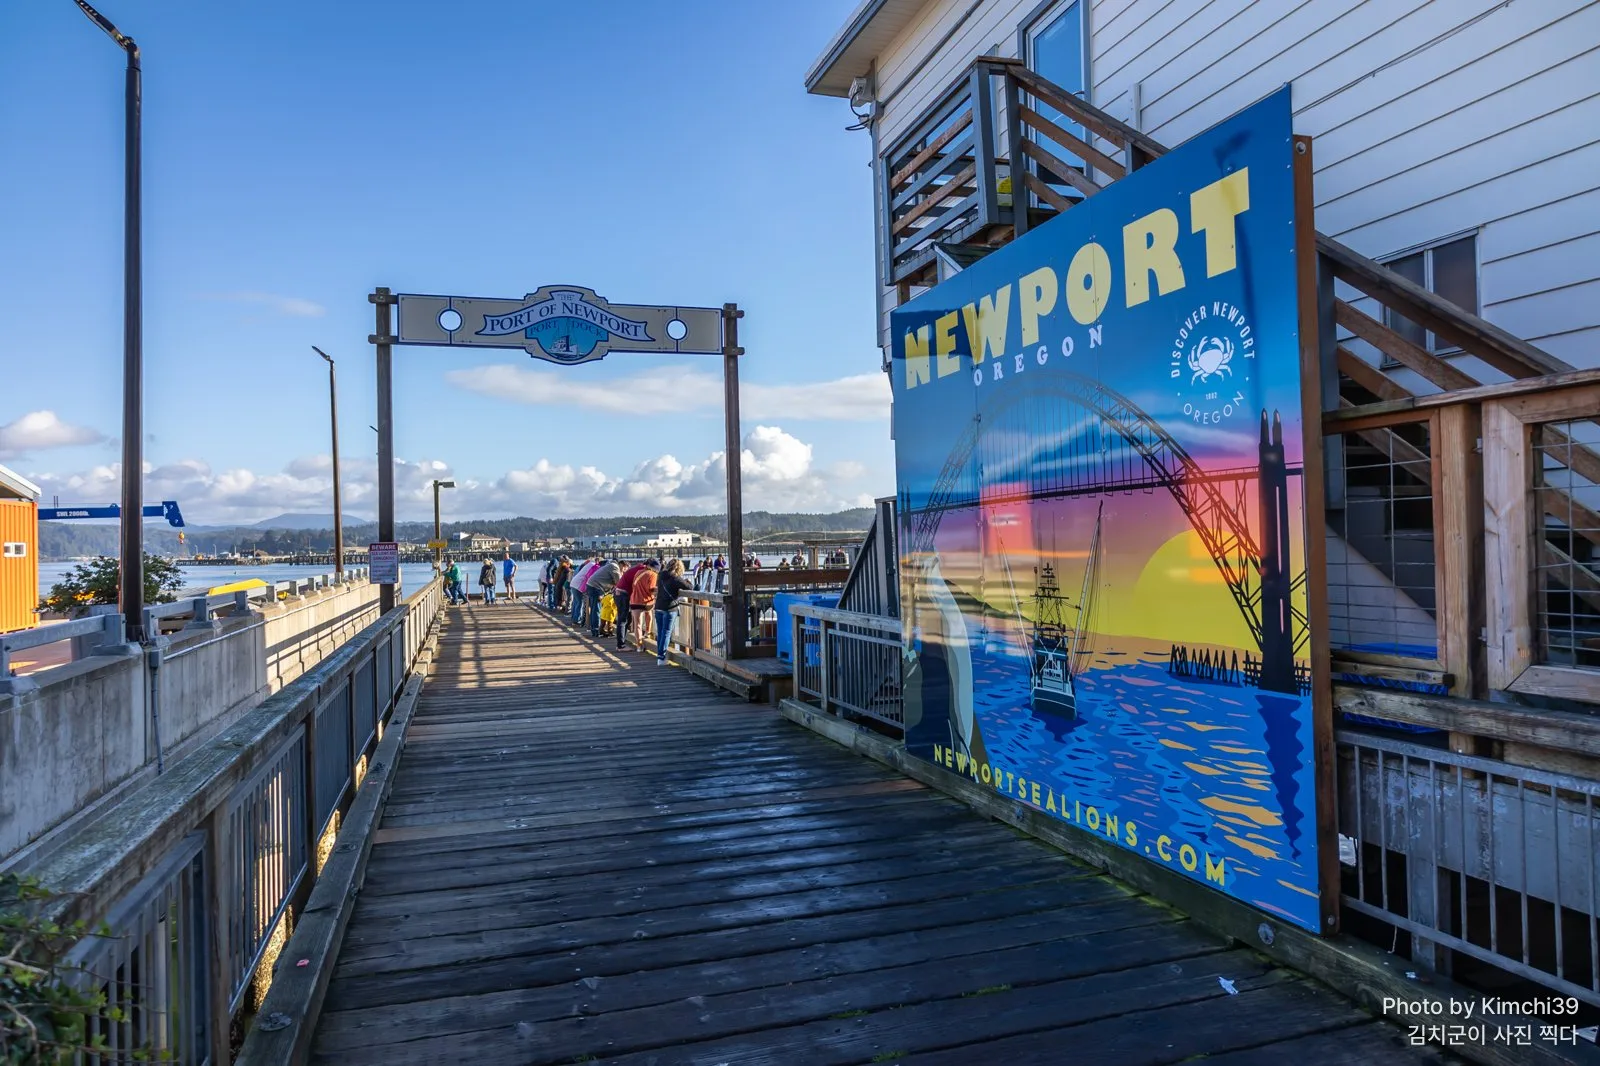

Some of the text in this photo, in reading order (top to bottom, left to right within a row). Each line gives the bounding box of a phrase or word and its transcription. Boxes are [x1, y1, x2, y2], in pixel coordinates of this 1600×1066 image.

[904, 166, 1250, 390] NEWPORT
[490, 302, 642, 337] PORT OF NEWPORT
[530, 319, 605, 337] PORT DOCK
[562, 334, 573, 353] 1
[1171, 301, 1255, 378] DISCOVER NEWPORT
[973, 324, 1104, 387] OREGON
[1183, 391, 1245, 424] OREGON
[933, 743, 1225, 886] NEWPORTSEALIONS.COM
